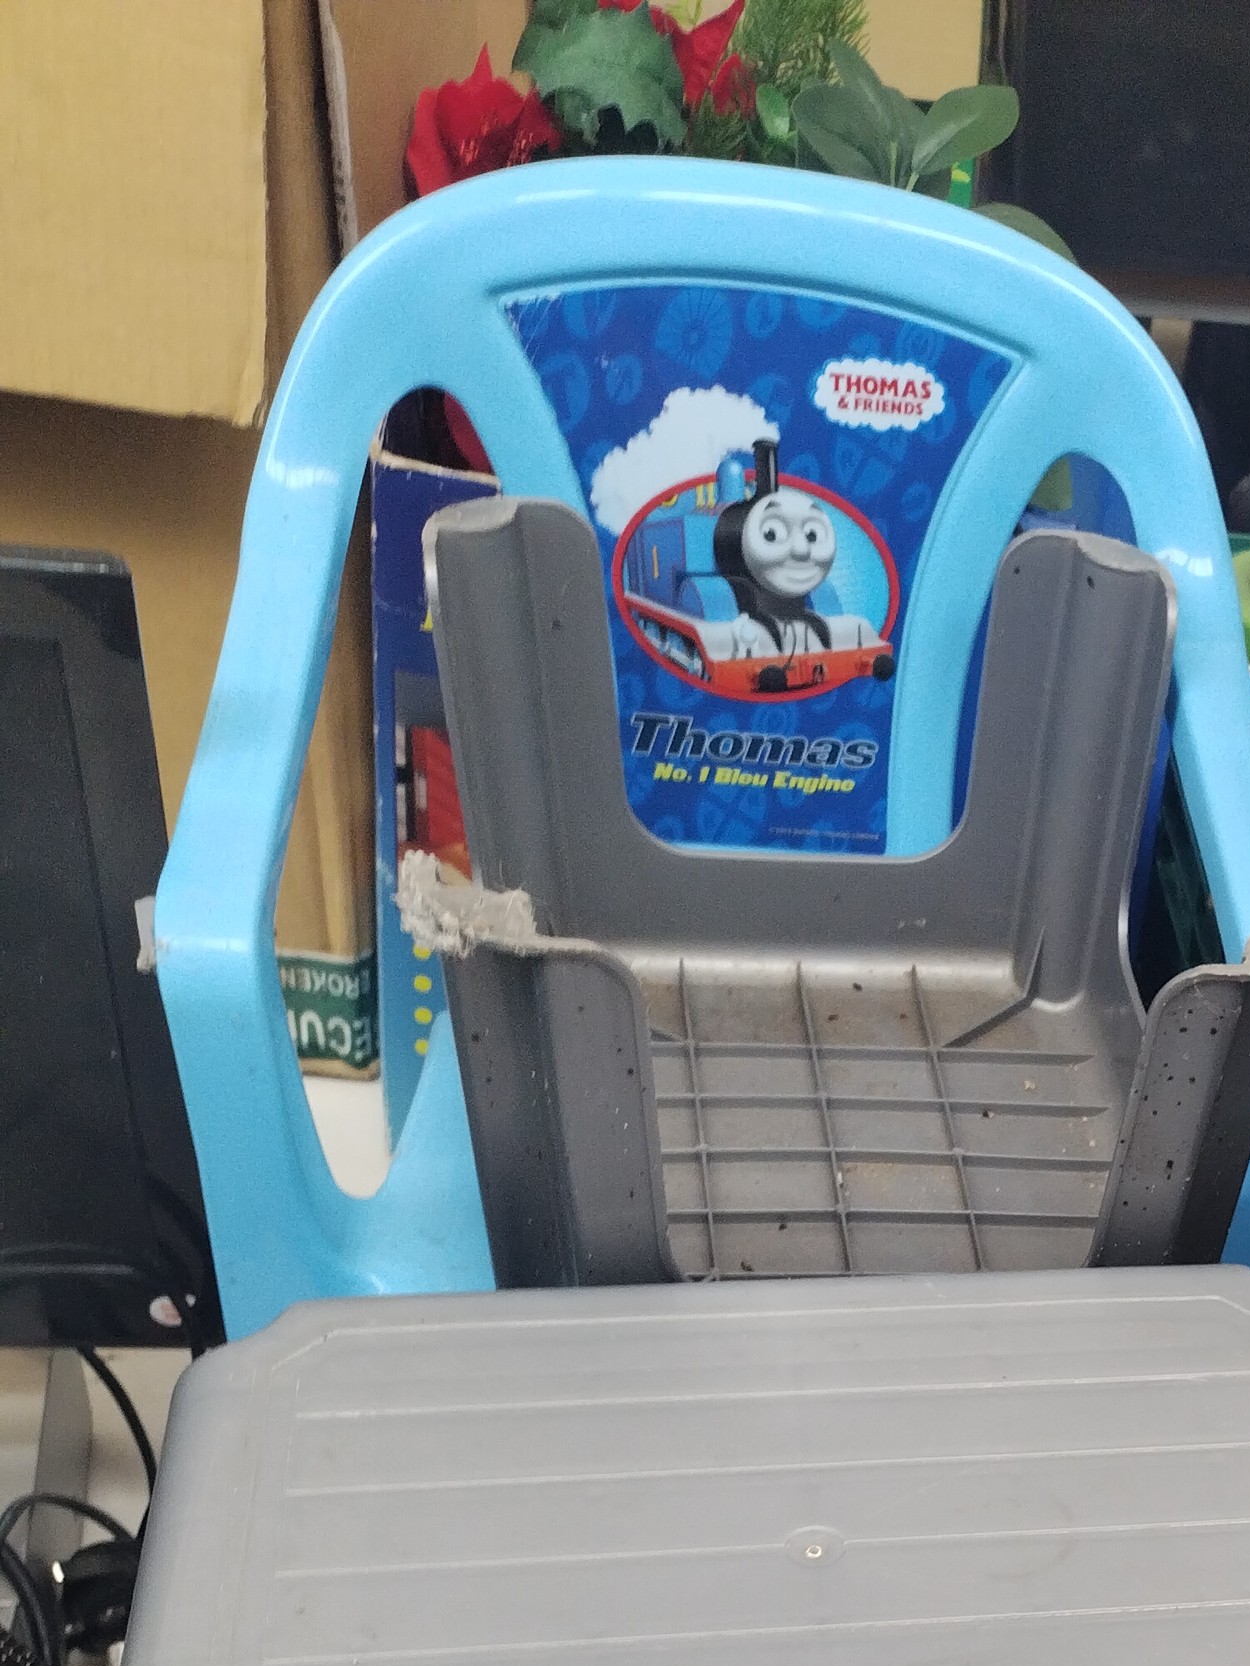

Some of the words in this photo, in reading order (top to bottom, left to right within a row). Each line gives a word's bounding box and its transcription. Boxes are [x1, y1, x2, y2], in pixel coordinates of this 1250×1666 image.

[829, 372, 932, 400] THOMAS
[837, 395, 849, 411] &
[853, 397, 924, 416] FRIENDS
[631, 712, 879, 770] Thomas
[653, 762, 693, 784] No.
[714, 767, 768, 788] Bleu
[772, 770, 857, 796] Engine
